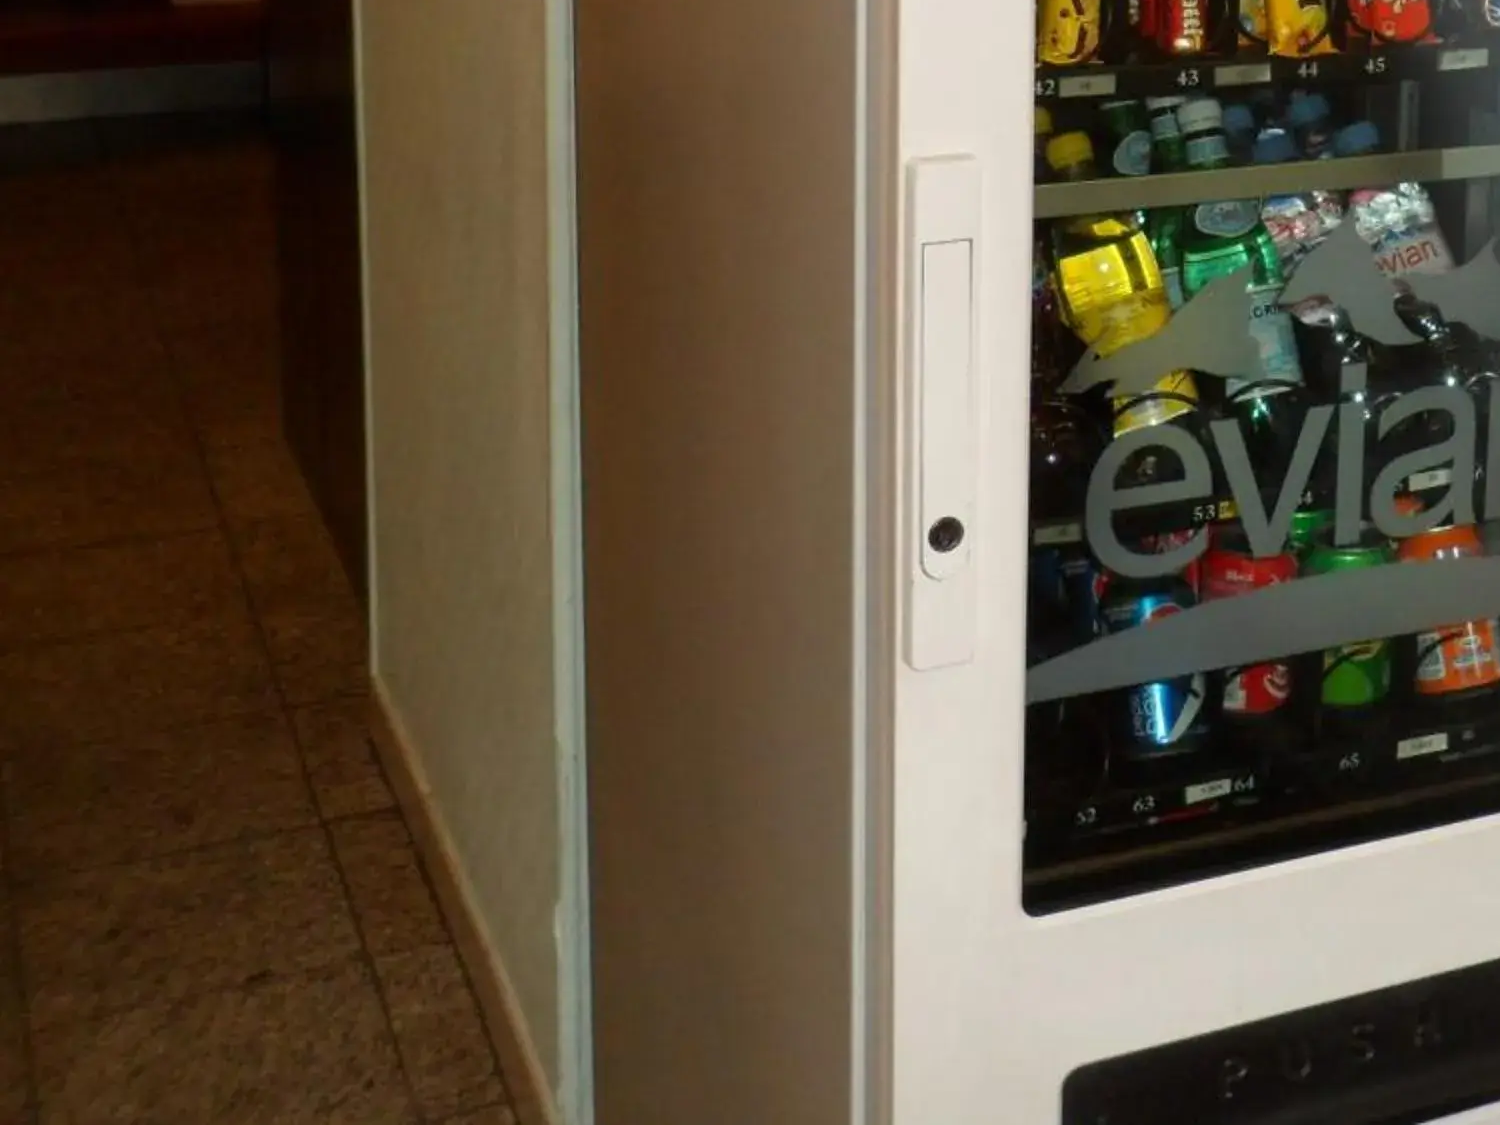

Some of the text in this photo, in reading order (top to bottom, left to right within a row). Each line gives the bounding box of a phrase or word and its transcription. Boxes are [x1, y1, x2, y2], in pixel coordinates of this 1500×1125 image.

[1178, 70, 1199, 86] 43
[1298, 62, 1319, 77] 44
[1365, 58, 1386, 74] 45
[1192, 505, 1217, 523] 53
[1339, 753, 1361, 771] 65
